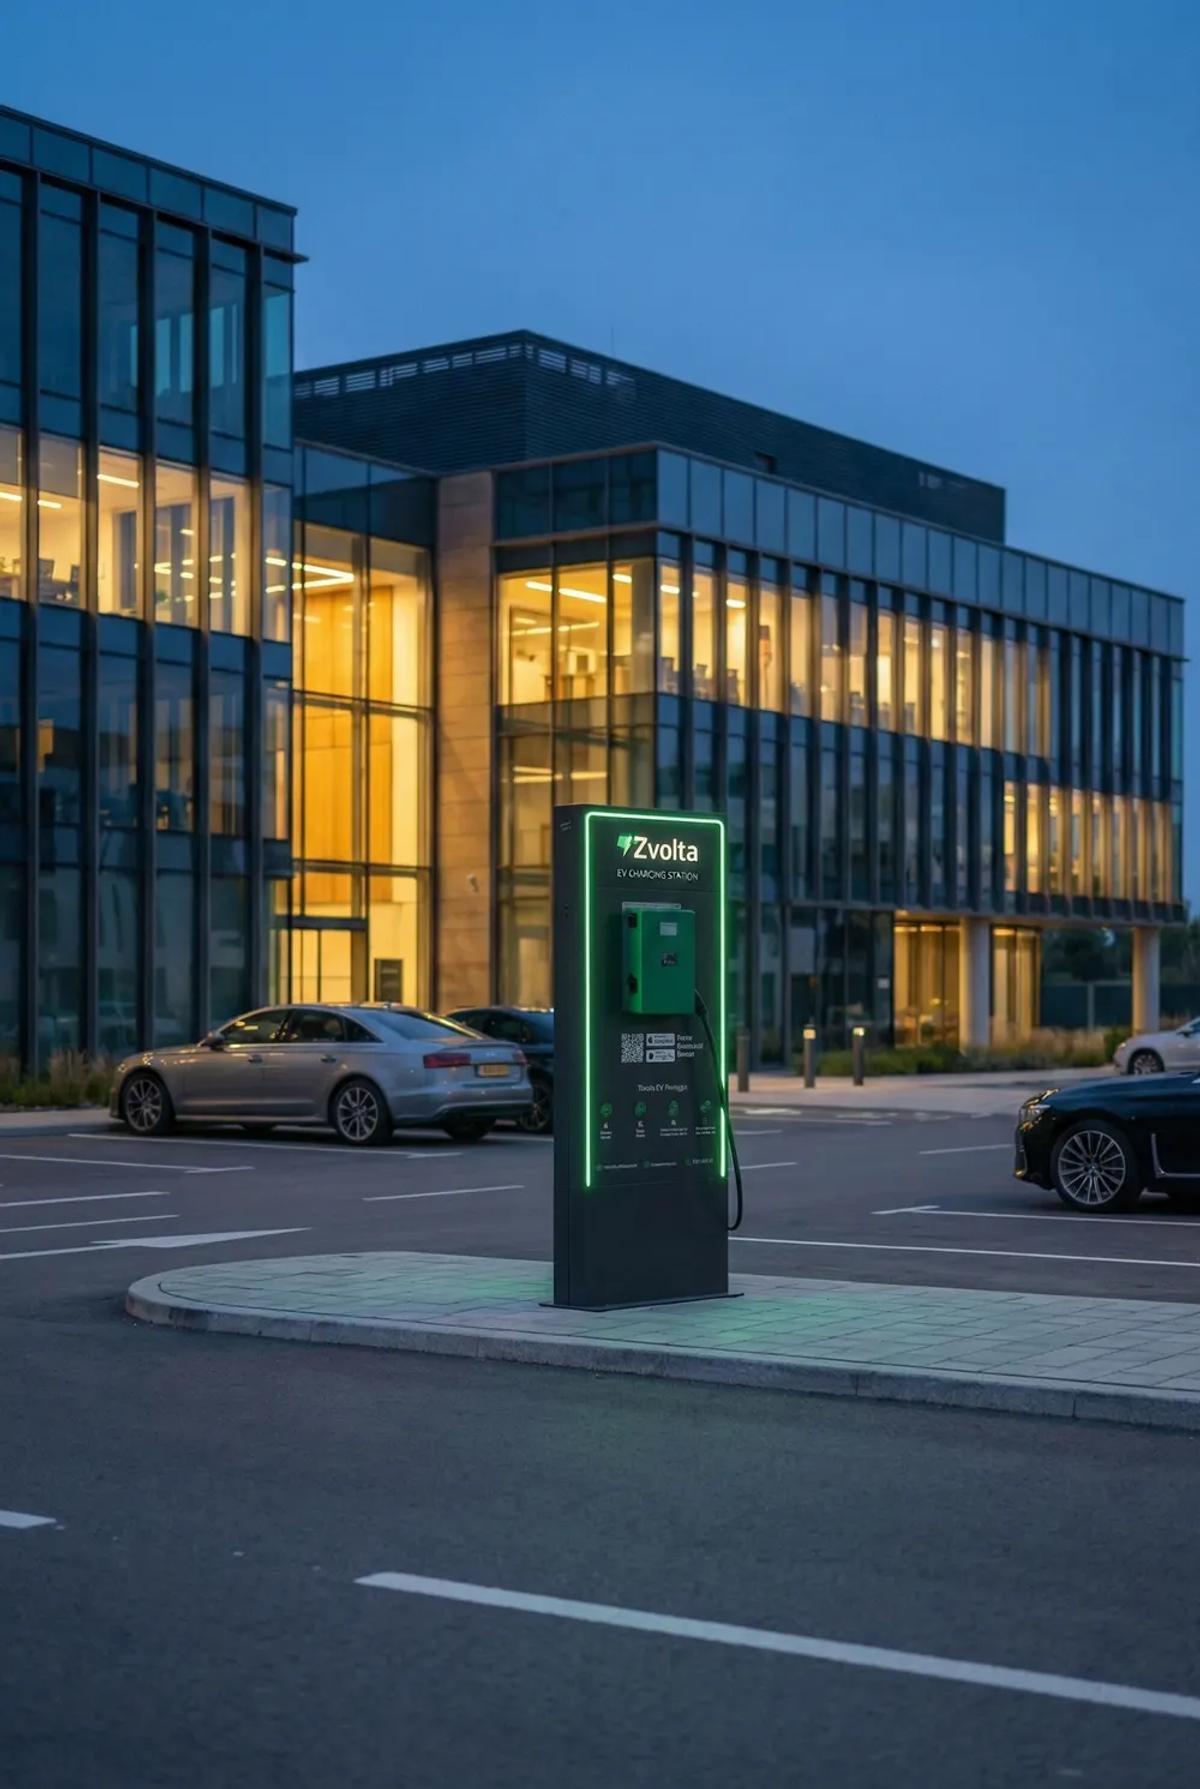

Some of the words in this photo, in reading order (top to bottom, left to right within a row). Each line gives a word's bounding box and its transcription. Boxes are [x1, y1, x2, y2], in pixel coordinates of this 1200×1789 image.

[633, 835, 698, 862] Zvolta
[616, 868, 628, 878] EV
[667, 871, 698, 881] STATION
